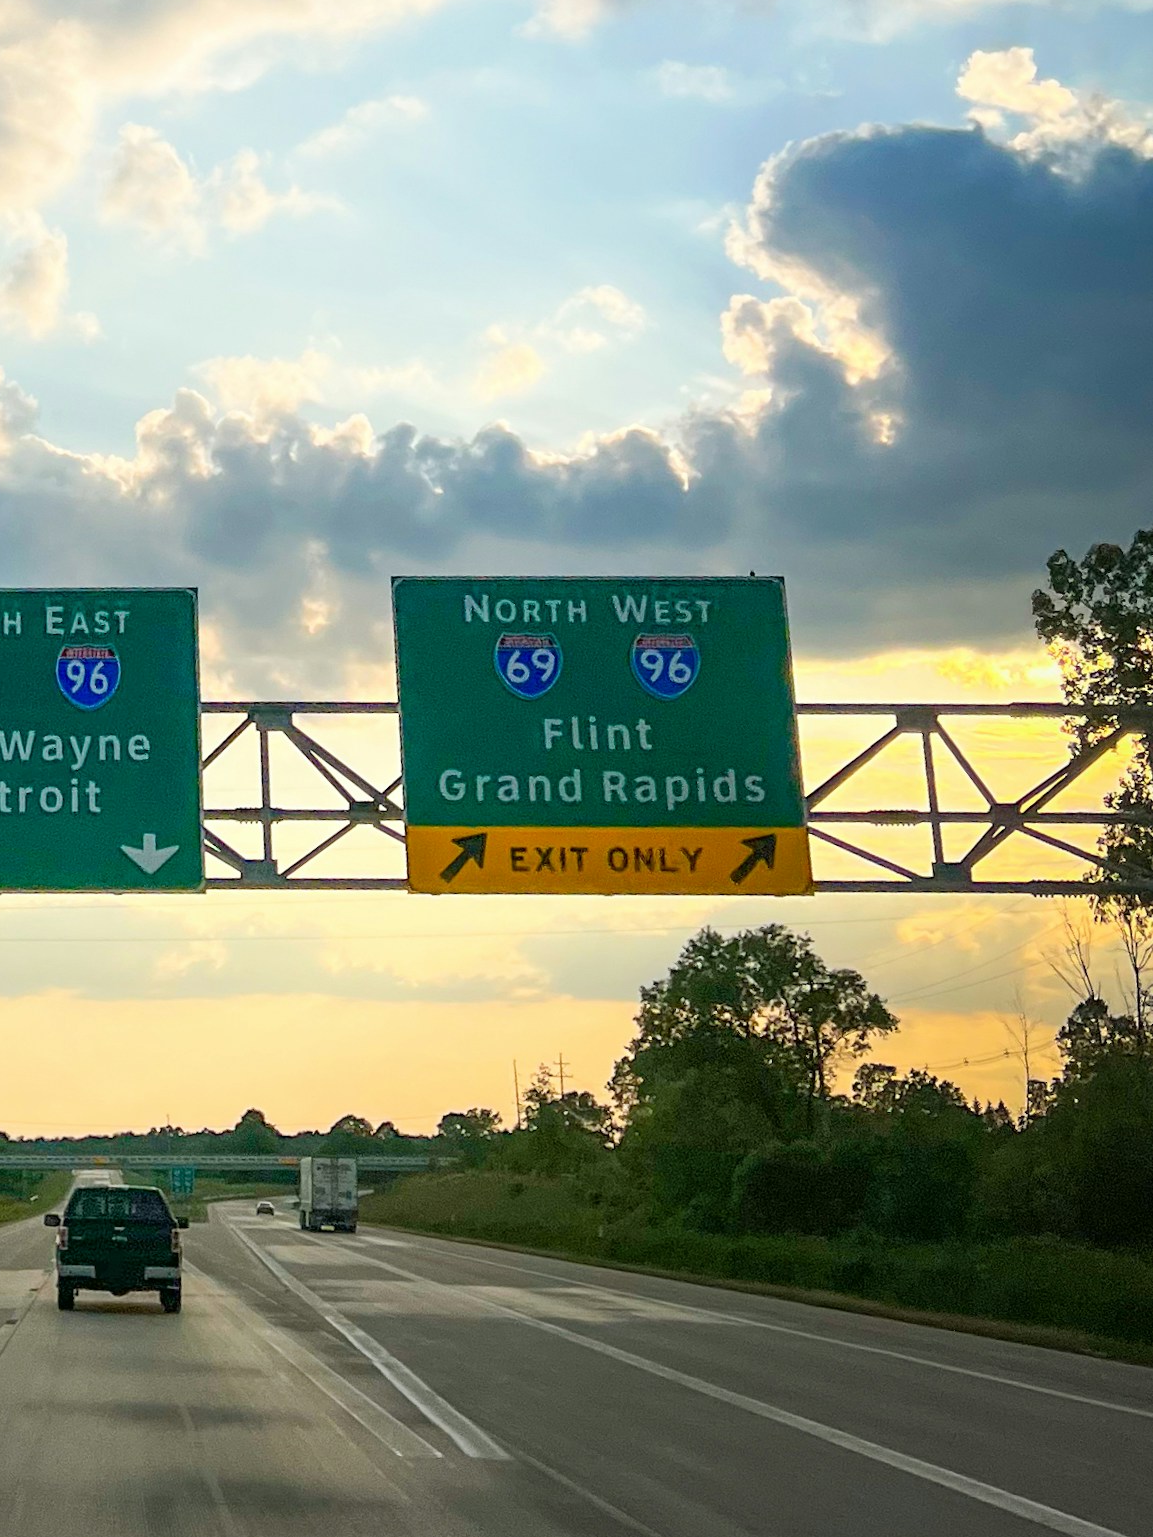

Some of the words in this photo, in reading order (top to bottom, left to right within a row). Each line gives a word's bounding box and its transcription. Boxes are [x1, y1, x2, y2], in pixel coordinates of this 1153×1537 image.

[45, 606, 131, 636] EAST
[464, 593, 588, 624] NORTH
[612, 594, 712, 624] WEST
[66, 660, 109, 695] 96
[506, 649, 556, 684] 69
[640, 650, 692, 684] 96
[543, 716, 653, 751] Flint
[439, 768, 582, 803] Grand
[601, 768, 767, 811] Rapids
[510, 846, 589, 873] EXIT
[607, 847, 703, 874] ONLY
